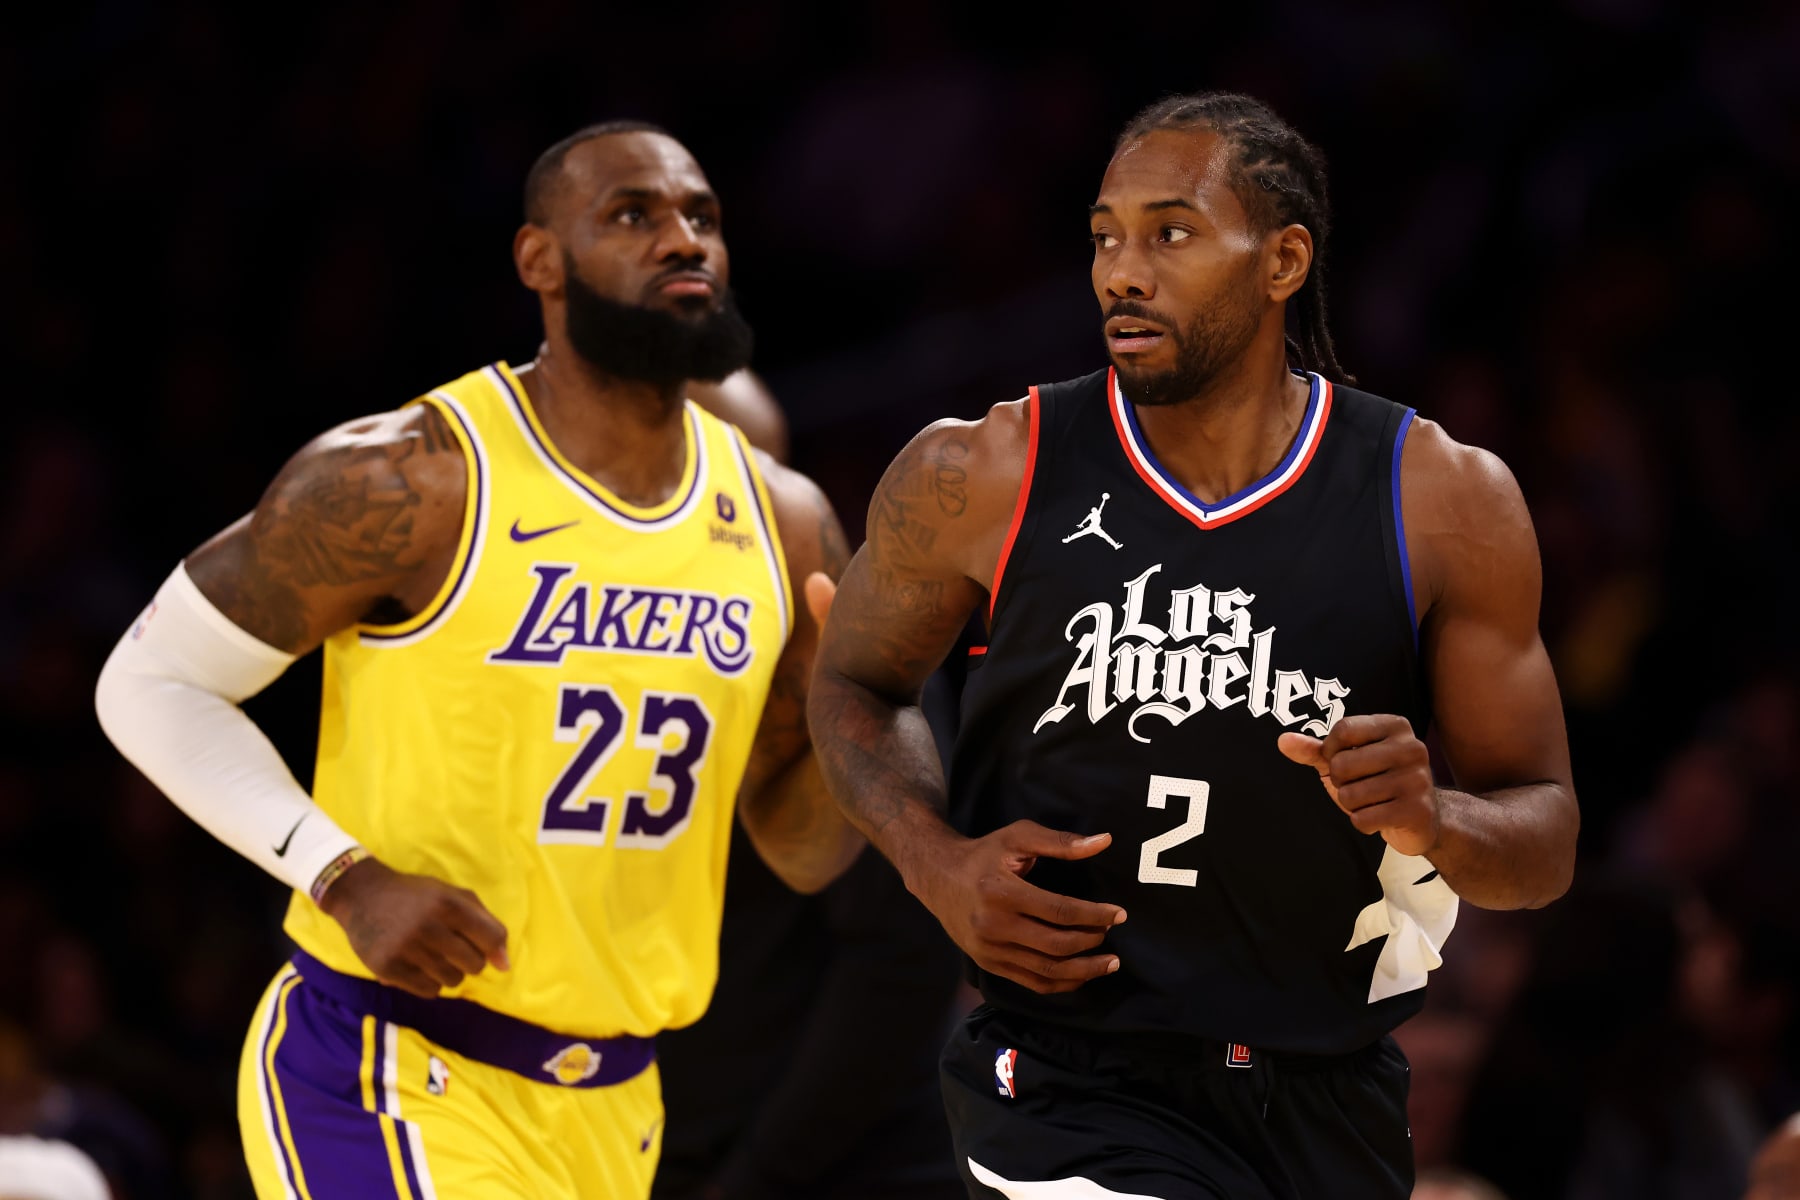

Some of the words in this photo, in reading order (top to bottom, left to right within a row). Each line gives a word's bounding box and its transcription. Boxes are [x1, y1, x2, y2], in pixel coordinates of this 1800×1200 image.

[487, 565, 755, 677] LAKERS
[1112, 564, 1255, 650] Los
[1033, 602, 1350, 744] Angeles
[538, 684, 715, 850] 23
[1138, 774, 1210, 887] 2
